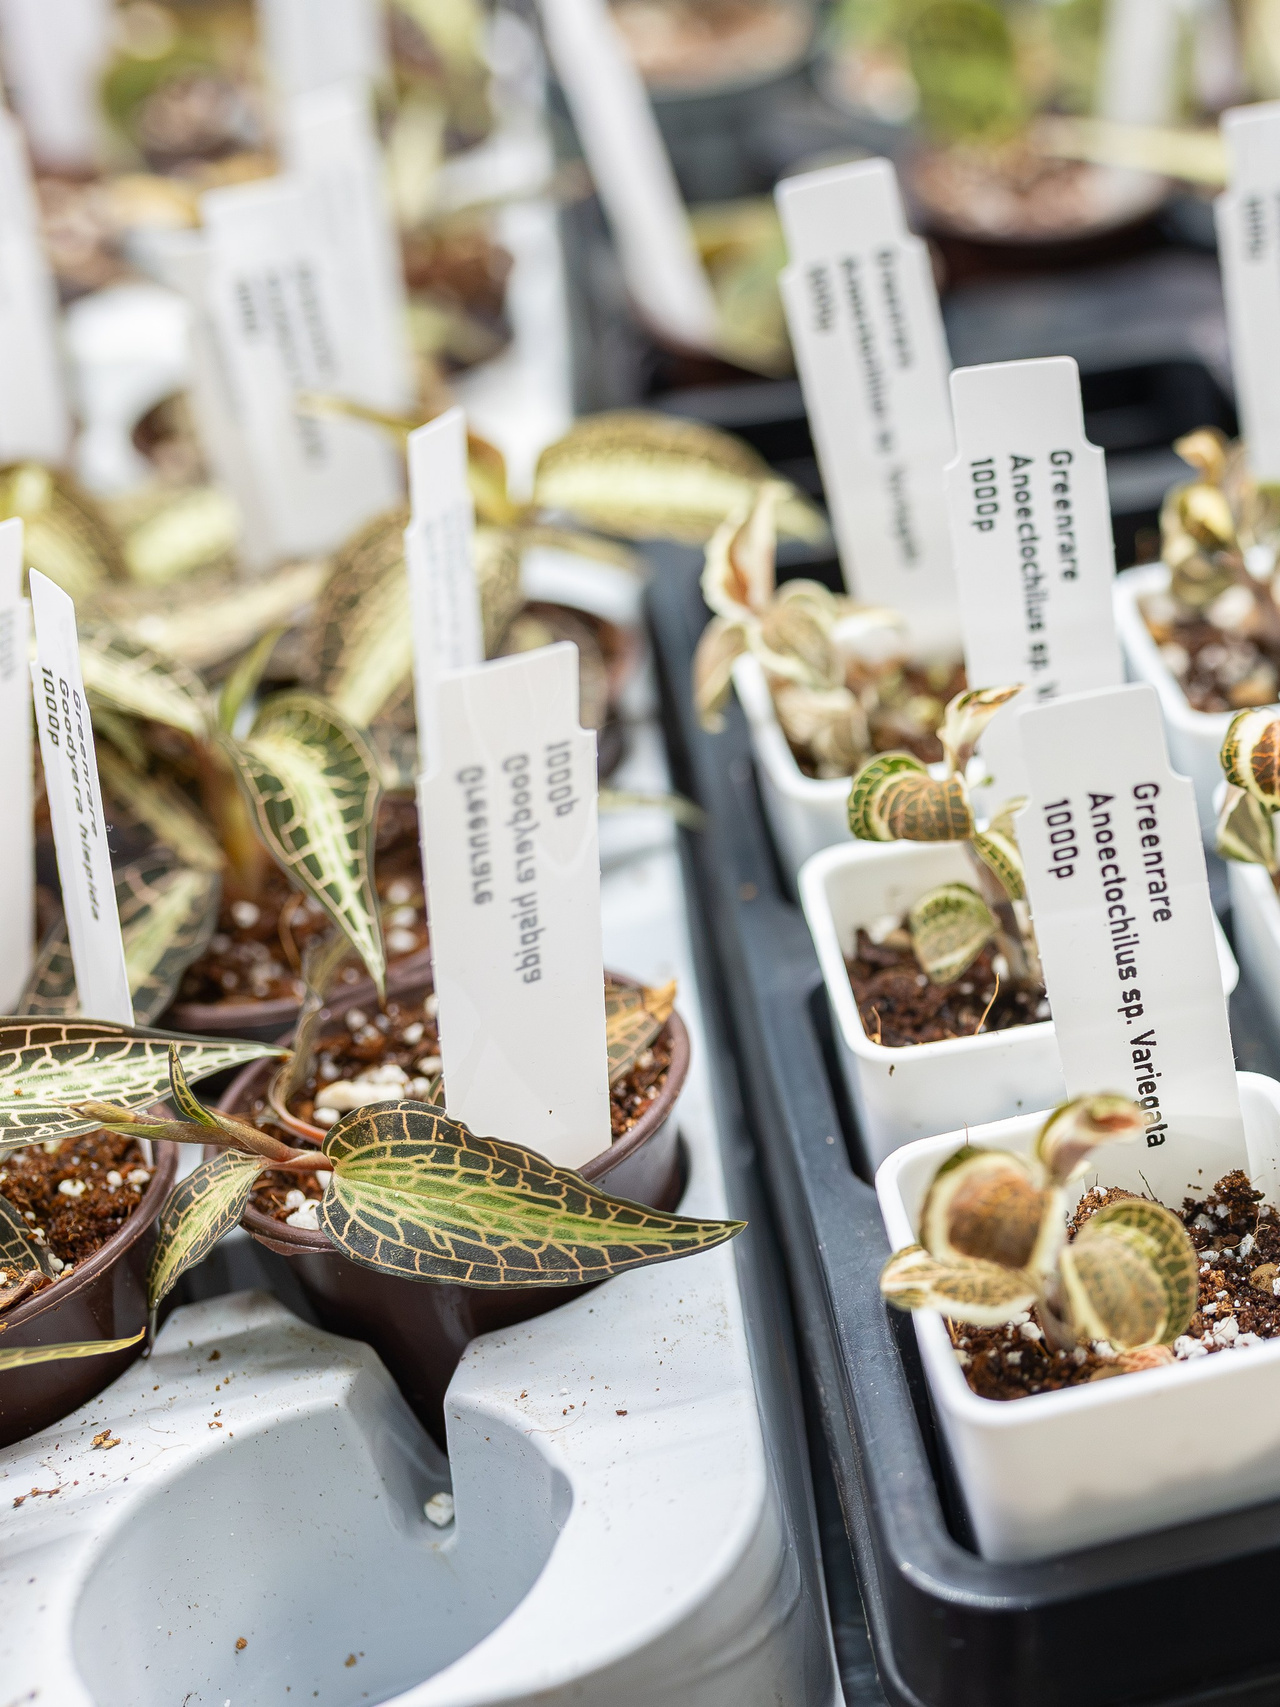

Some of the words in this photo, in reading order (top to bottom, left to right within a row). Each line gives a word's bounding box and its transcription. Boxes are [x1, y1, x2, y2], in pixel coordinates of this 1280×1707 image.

[41, 668, 60, 747] 1000p
[73, 689, 98, 838] Greenrare
[59, 676, 83, 814] Goodyera
[79, 822, 100, 921] hispida
[1044, 799, 1078, 879] 1000p
[1133, 783, 1173, 923] Greenrare
[1088, 792, 1140, 981] Anoectochilus
[1117, 990, 1144, 1025] sp.
